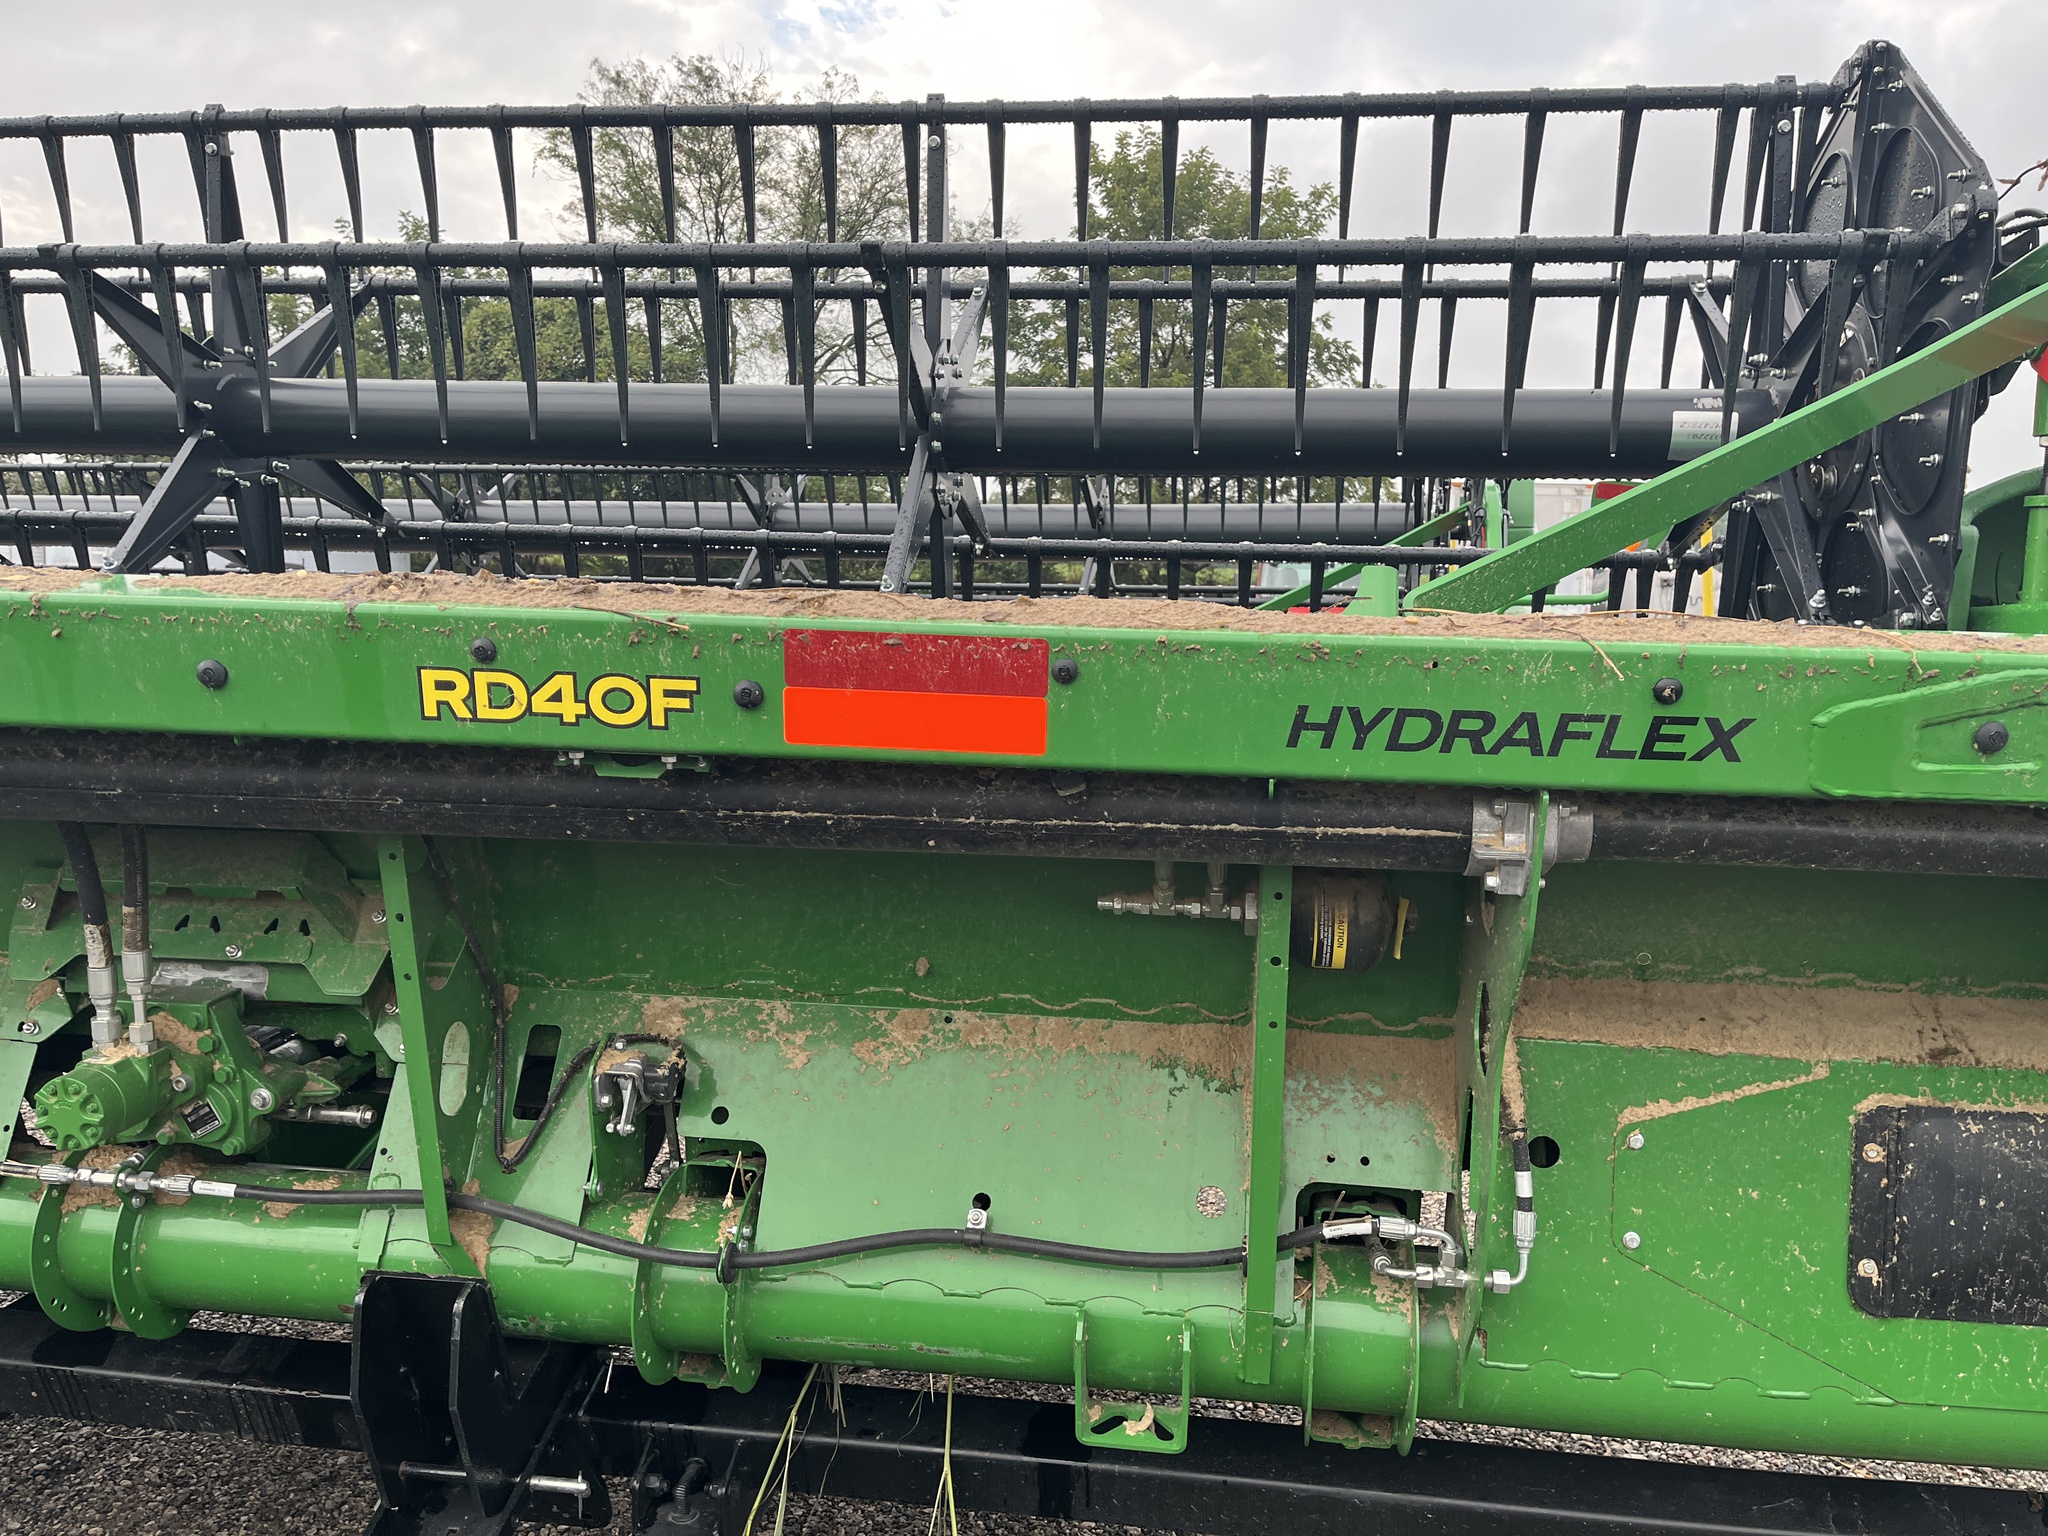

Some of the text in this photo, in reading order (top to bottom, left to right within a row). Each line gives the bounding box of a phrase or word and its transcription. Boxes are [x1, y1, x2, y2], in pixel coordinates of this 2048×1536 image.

[417, 666, 700, 730] RD40F
[1285, 704, 1757, 763] HYDRAFLEX
[1337, 912, 1345, 949] CAUTION
